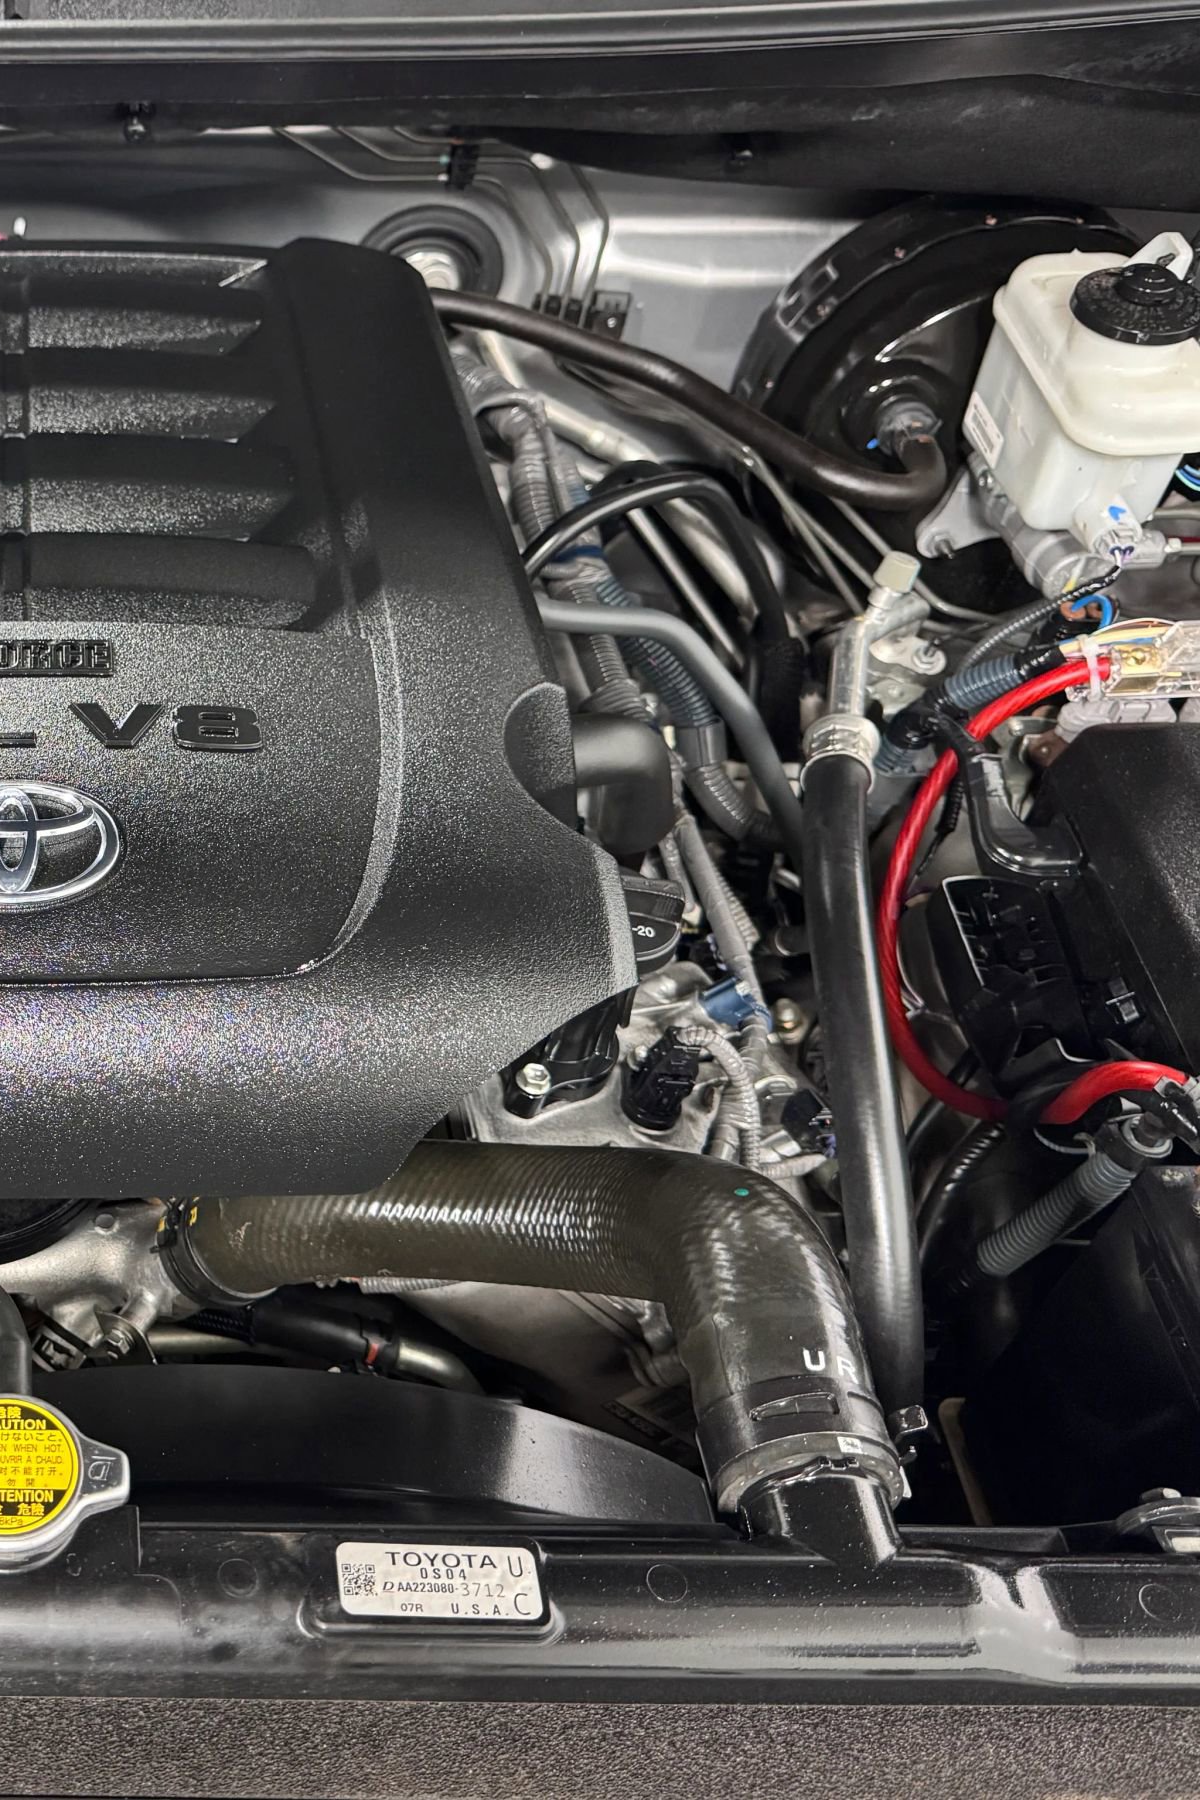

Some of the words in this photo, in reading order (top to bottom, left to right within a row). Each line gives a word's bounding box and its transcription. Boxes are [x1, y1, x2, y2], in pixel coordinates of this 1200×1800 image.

[68, 702, 263, 753] V8
[13, 1443, 38, 1453] WHEN
[384, 1551, 498, 1570] TOYOTA
[513, 1592, 532, 1616] C
